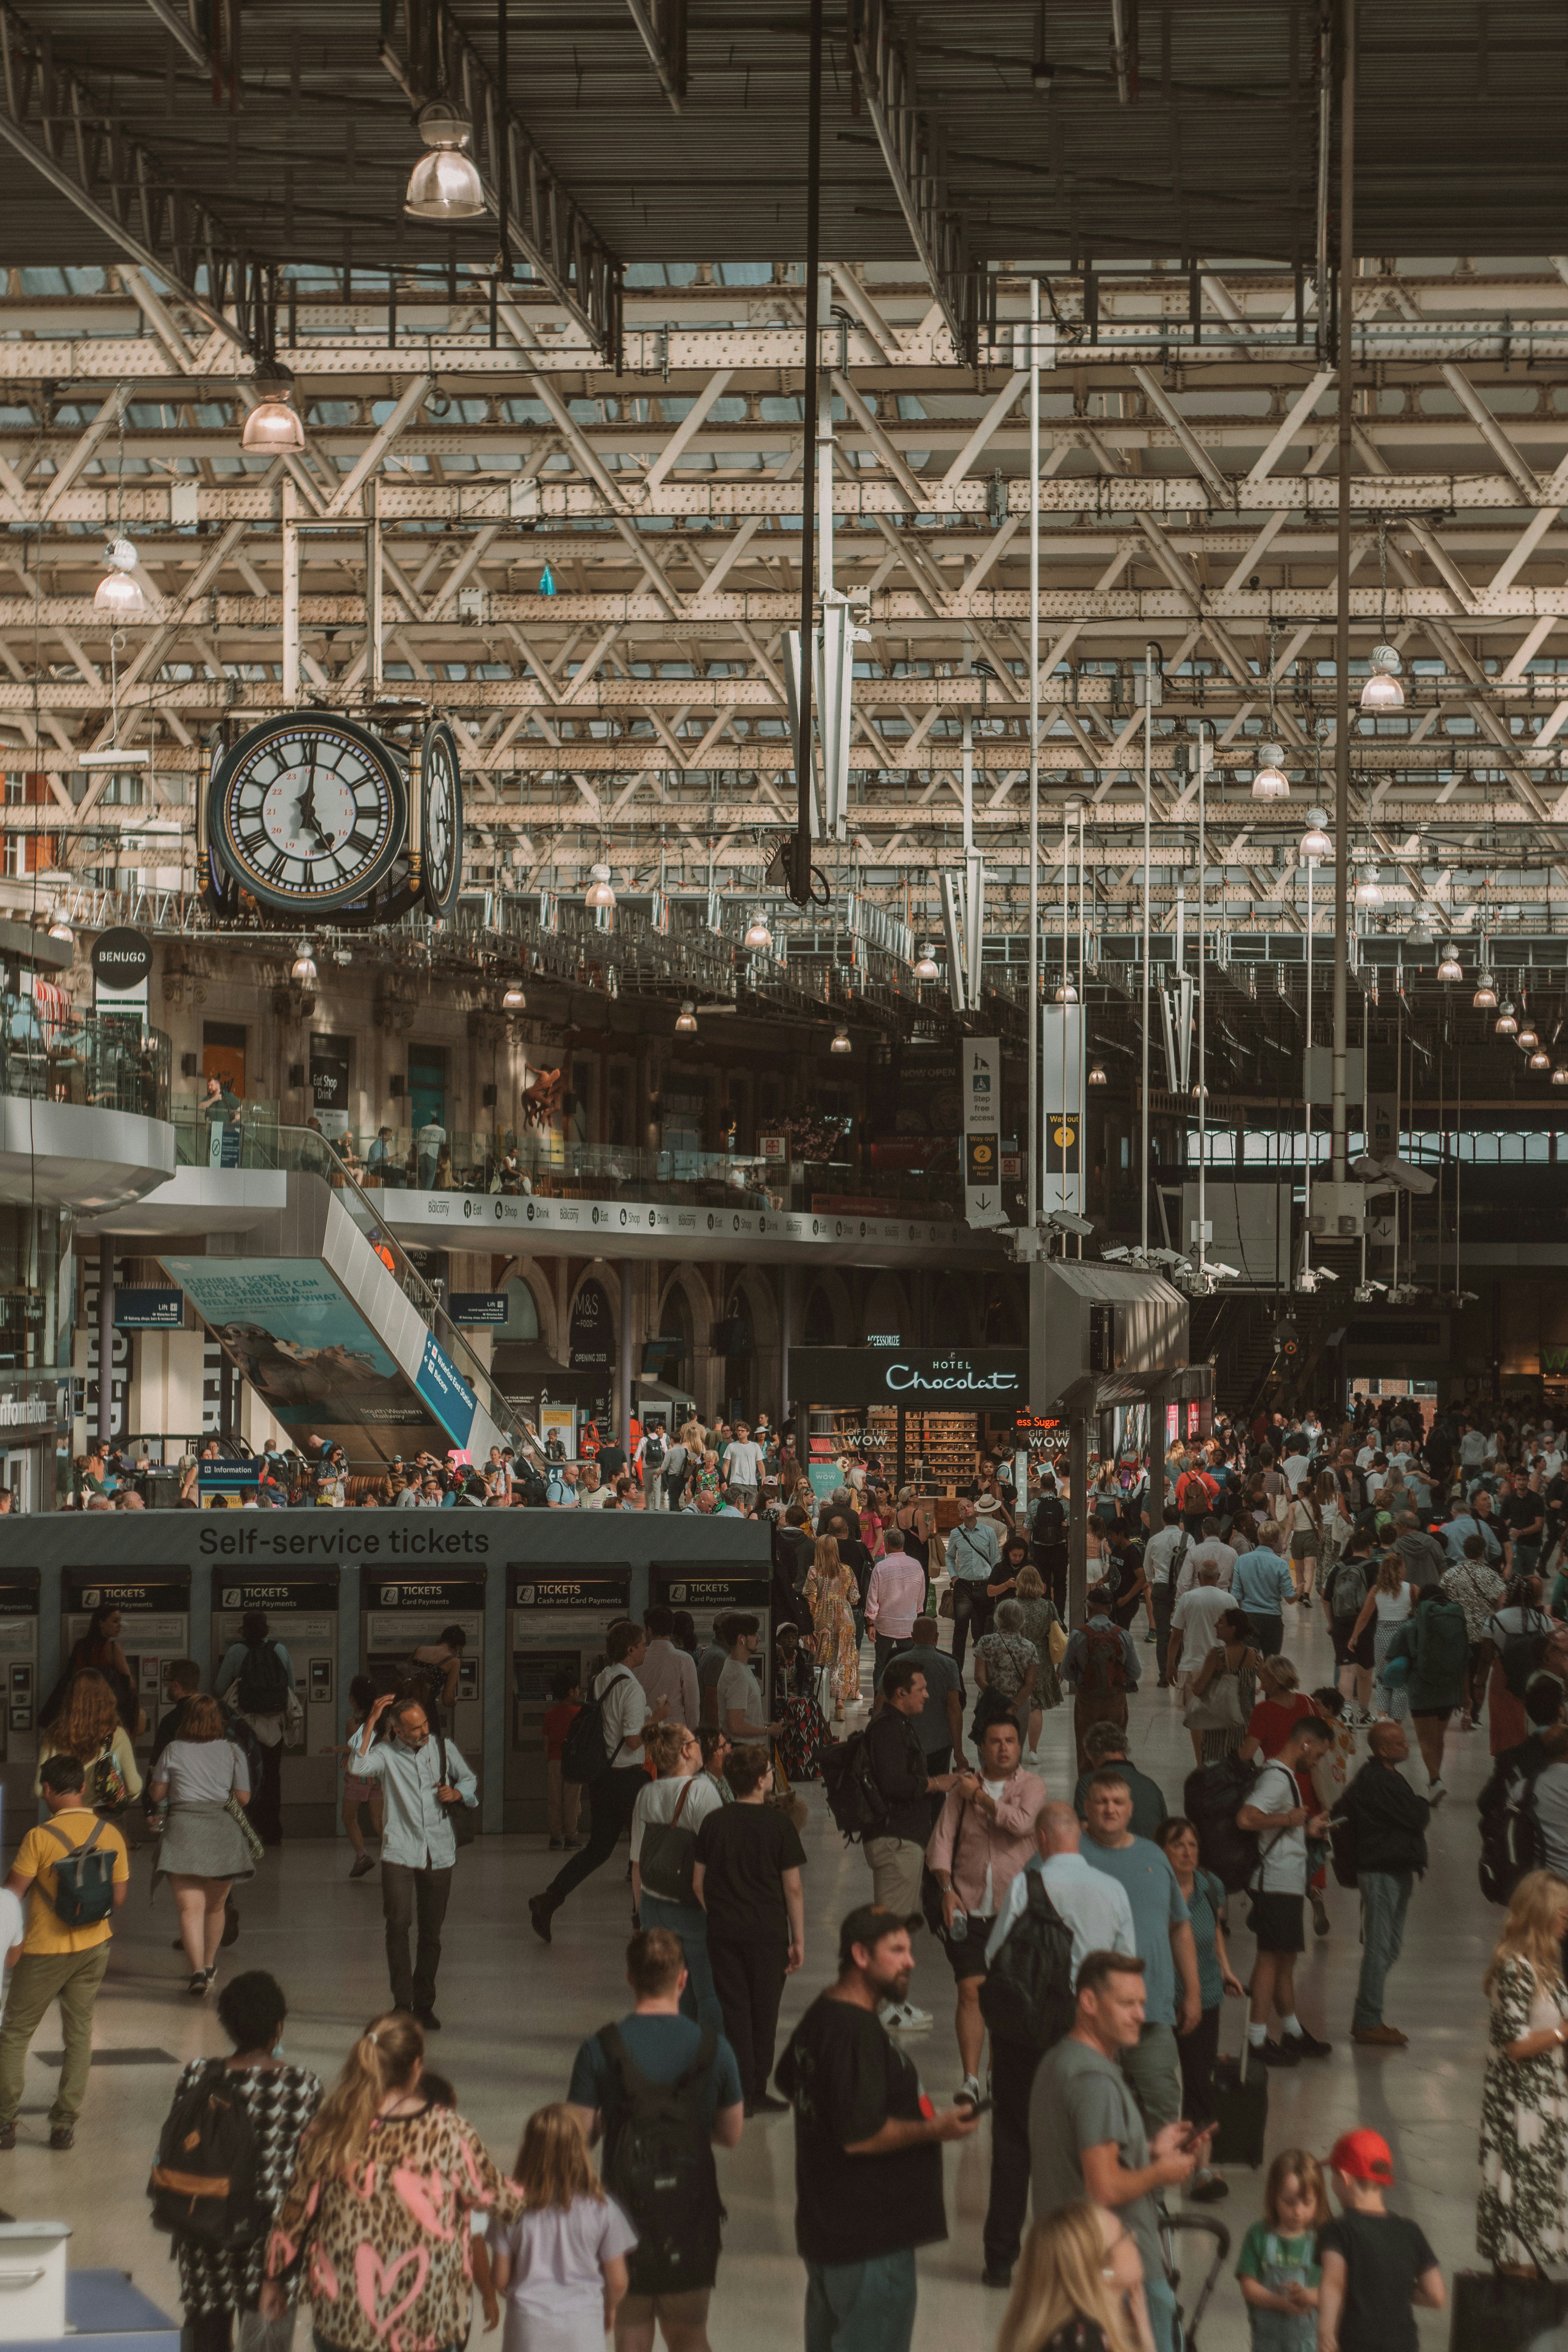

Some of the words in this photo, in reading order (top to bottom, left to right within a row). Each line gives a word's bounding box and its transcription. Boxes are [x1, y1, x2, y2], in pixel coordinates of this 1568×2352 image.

[100, 951, 145, 963] BENUGO
[314, 1074, 323, 1086] Eat
[323, 1074, 337, 1091] Shop
[318, 1088, 332, 1100] Drink
[980, 1150, 985, 1158] 2
[428, 1201, 449, 1216] Balcony
[473, 1204, 482, 1215] Eat
[505, 1205, 517, 1219] Shop
[536, 1207, 549, 1218] Drink
[560, 1209, 579, 1223] Balcony
[628, 1212, 640, 1225] Shop
[657, 1214, 669, 1224] Drink
[679, 1216, 696, 1229] Balcony
[741, 1218, 751, 1231] Shop
[767, 1220, 778, 1230] Drink
[786, 1221, 802, 1234] Balcony
[843, 1225, 853, 1235] Shop
[183, 1277, 237, 1285] FLEXIBLE
[239, 1274, 281, 1283] TICKET
[292, 1279, 319, 1287] CAN
[241, 1288, 270, 1296] FREE
[576, 1294, 598, 1315] M&S
[575, 1354, 595, 1362] OPENING
[596, 1353, 606, 1362] 2023
[434, 1369, 448, 1394] Balcony
[437, 1354, 453, 1381] Waterloo
[452, 1376, 461, 1392] East
[460, 1388, 473, 1410] Station
[0, 1393, 47, 1426] nformation
[1034, 1417, 1060, 1429] Sugar
[847, 1436, 888, 1446] WOW
[1029, 1437, 1070, 1447] WOW
[199, 1528, 380, 1555] Self-service
[388, 1528, 489, 1553] tickets
[104, 1589, 145, 1597] TICKETS
[244, 1588, 289, 1597] TICKETS
[402, 1586, 442, 1595] TICKETS
[537, 1585, 581, 1594] TICKETS
